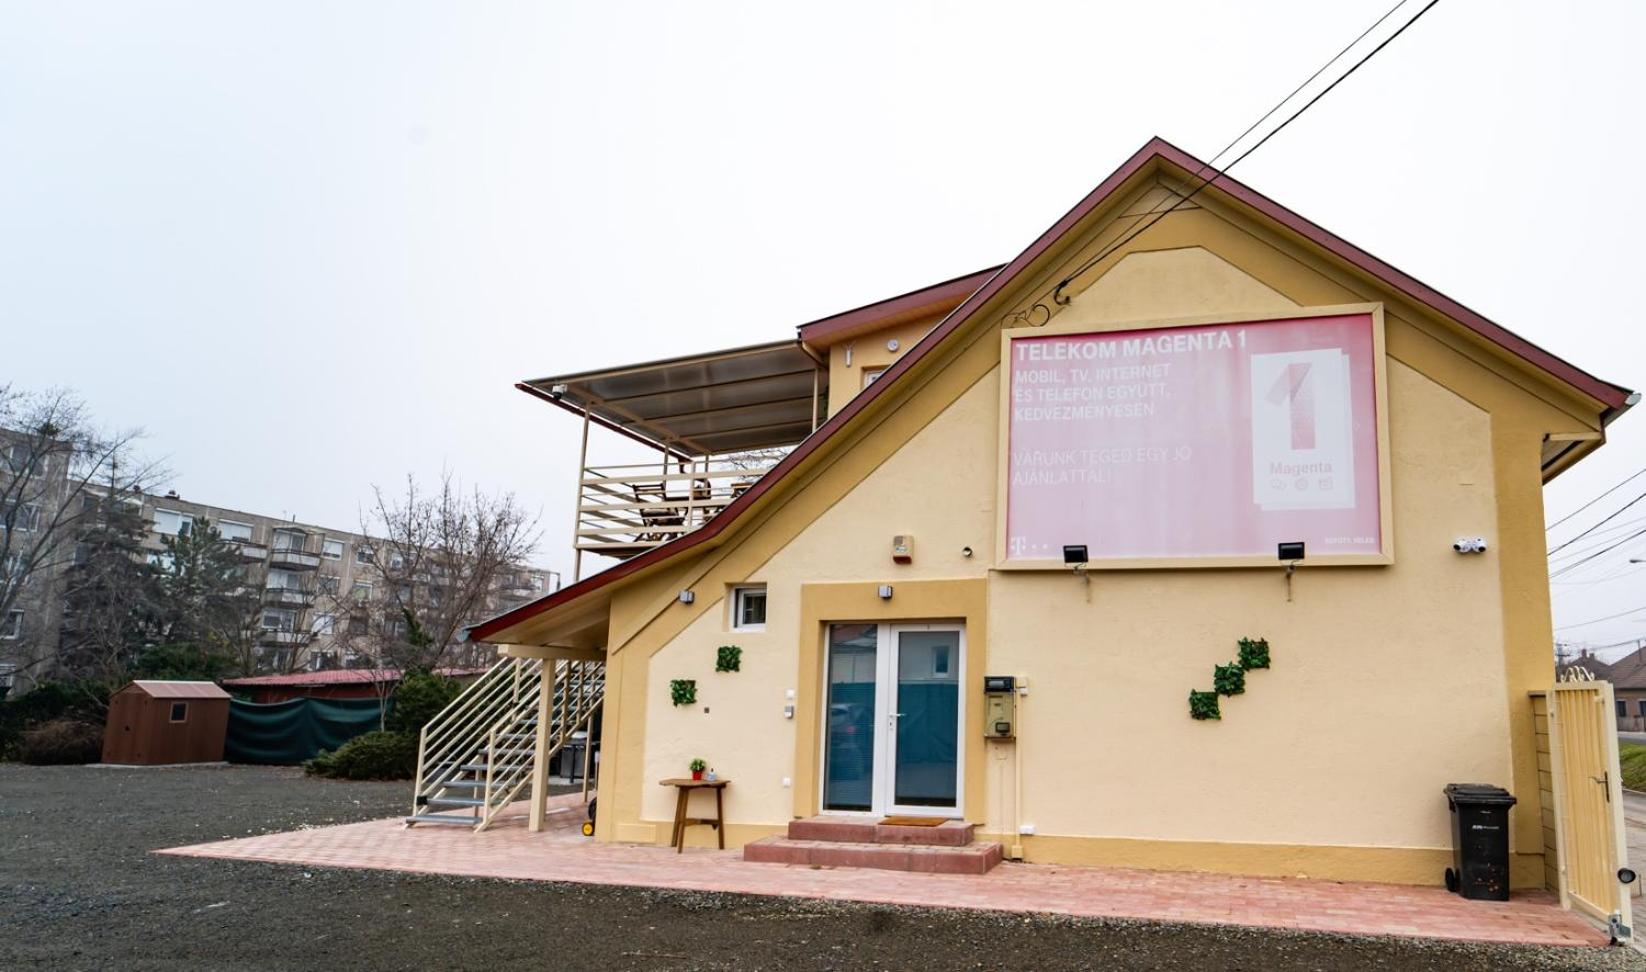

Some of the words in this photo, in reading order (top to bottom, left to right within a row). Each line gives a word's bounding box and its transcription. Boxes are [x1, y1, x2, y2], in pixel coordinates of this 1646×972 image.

[1016, 342, 1116, 361] TELEKOM
[1123, 331, 1233, 357] MAGENTA
[1237, 330, 1247, 347] 1
[1096, 363, 1171, 381] INTERNET
[1038, 385, 1103, 402] TELEFON
[1136, 447, 1168, 464] EGY
[1269, 460, 1333, 477] Magenta
